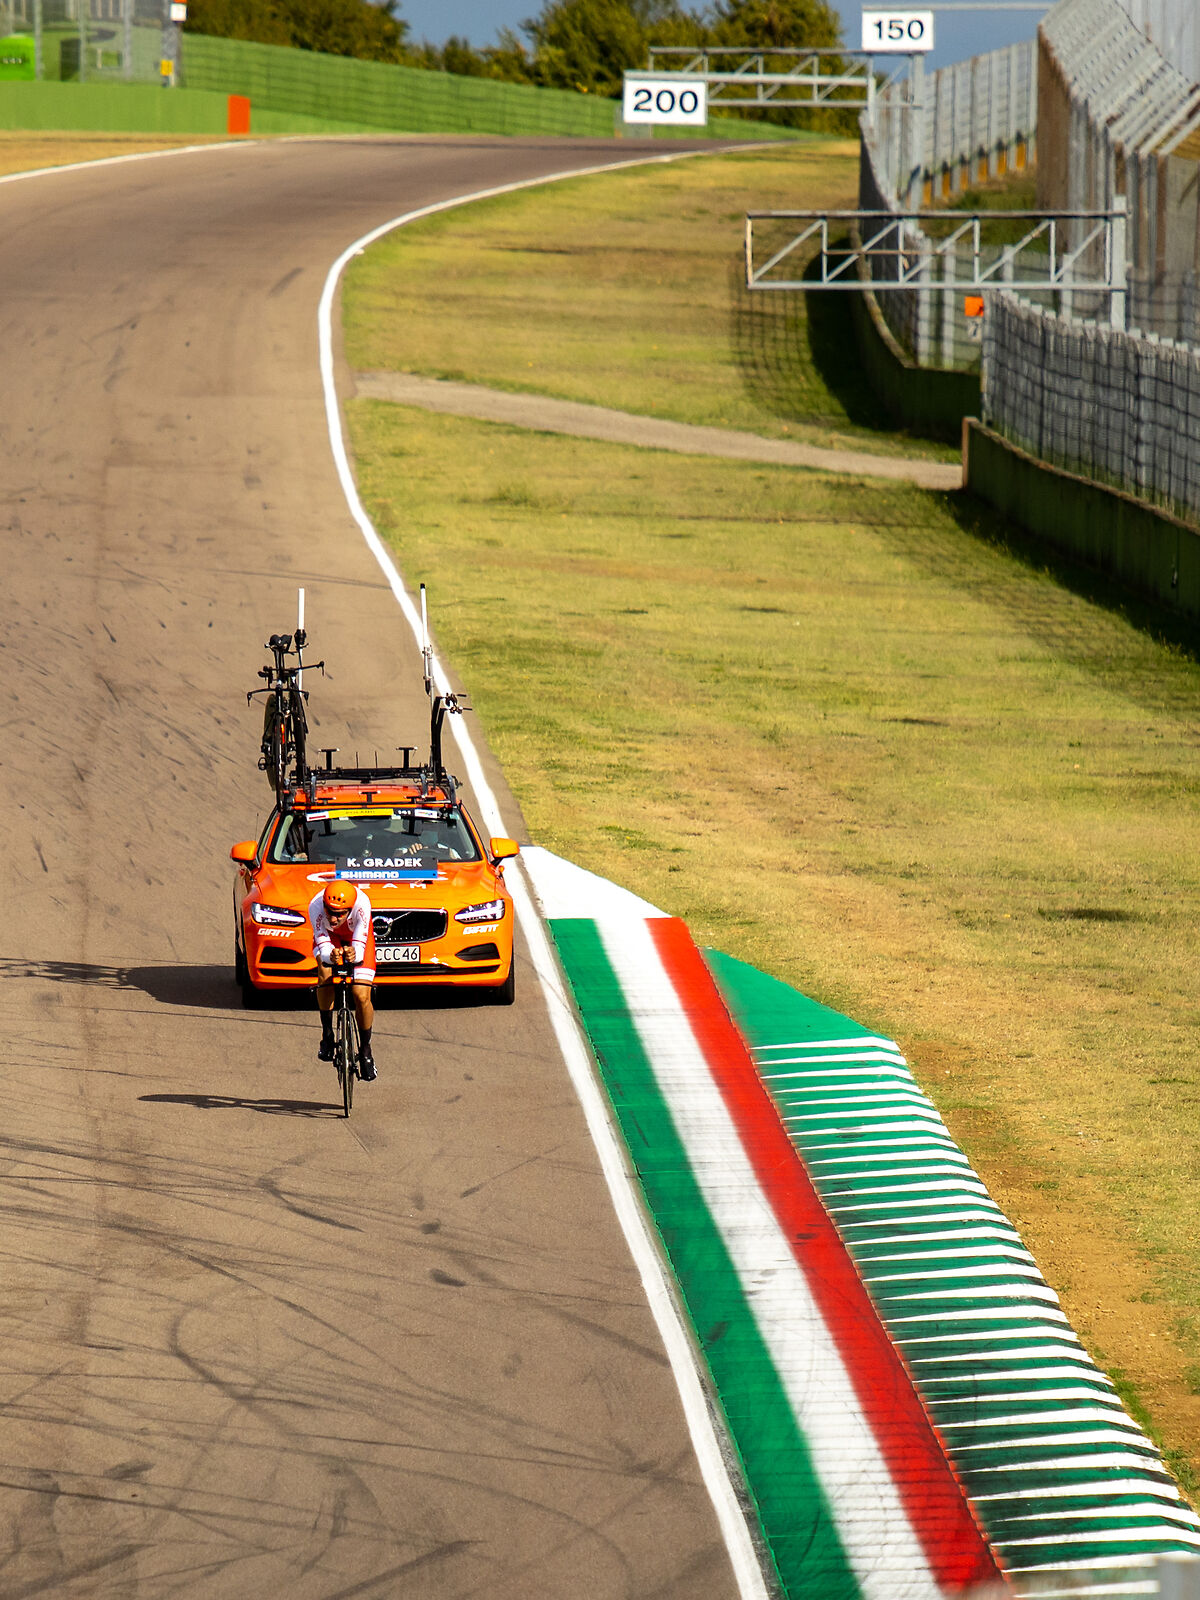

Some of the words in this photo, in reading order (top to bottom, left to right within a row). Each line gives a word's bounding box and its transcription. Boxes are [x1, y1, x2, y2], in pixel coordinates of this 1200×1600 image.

[873, 19, 924, 40] 150
[633, 88, 698, 113] 200
[347, 857, 360, 867] K.
[363, 857, 422, 868] GRADEK
[340, 870, 400, 879] SHIMANO
[257, 927, 296, 938] GIANT
